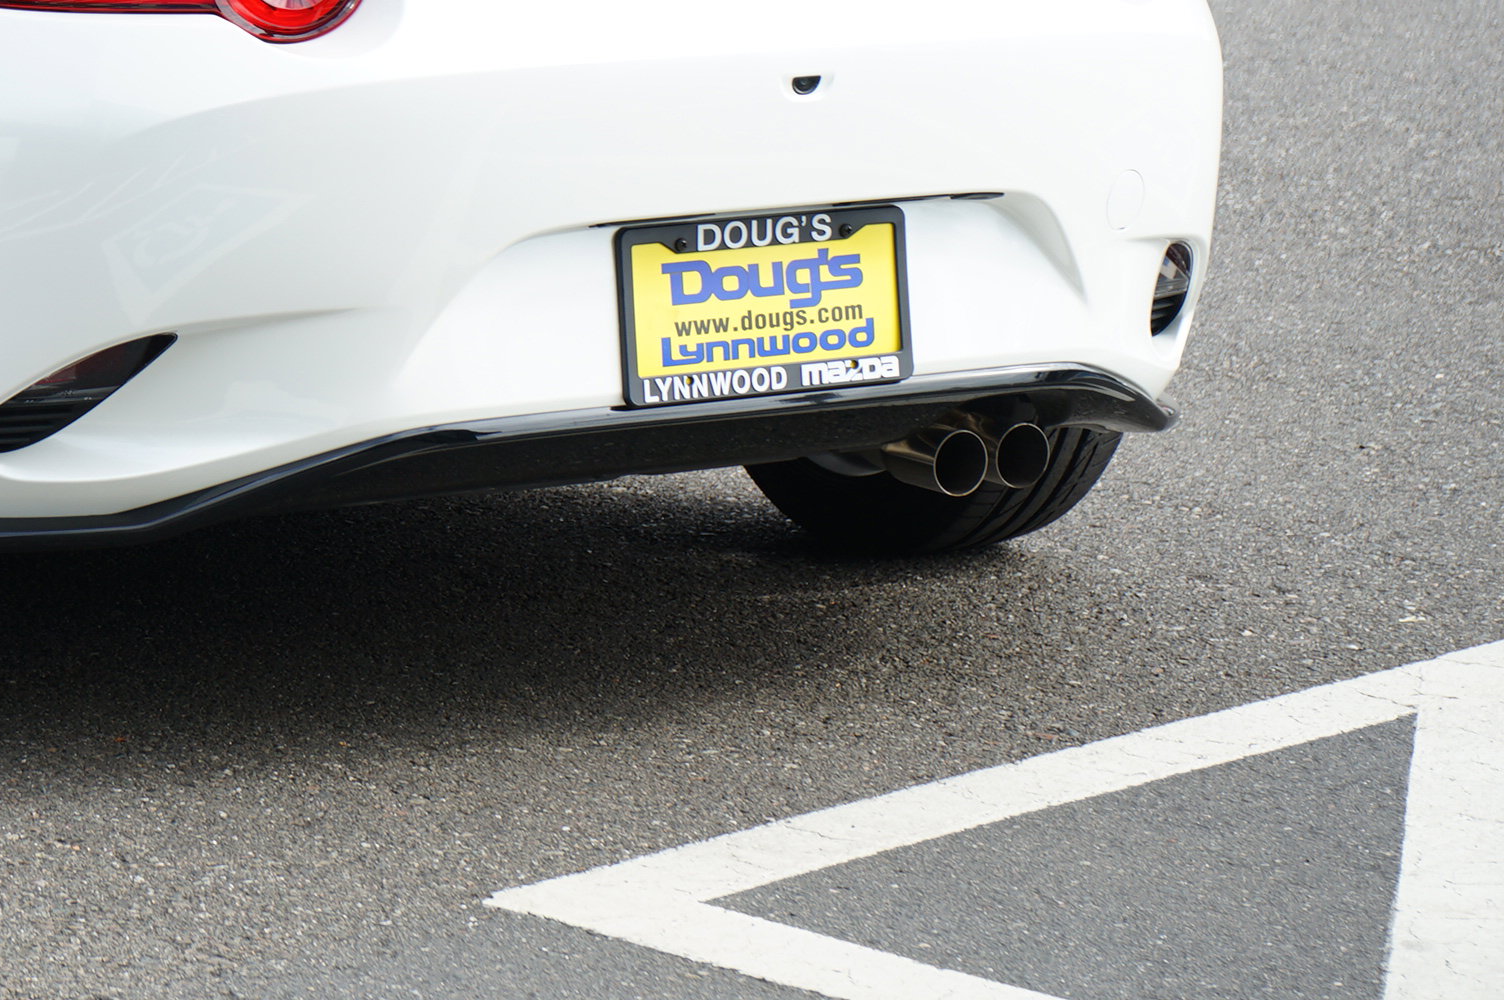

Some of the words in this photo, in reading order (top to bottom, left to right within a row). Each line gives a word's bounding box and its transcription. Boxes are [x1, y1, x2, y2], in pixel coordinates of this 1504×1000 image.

[697, 214, 832, 252] DOUG'S
[661, 248, 863, 309] Doug's
[674, 304, 863, 337] www.dougs.com
[661, 317, 874, 367] Lynnwood
[643, 366, 788, 403] LYNNWOOD
